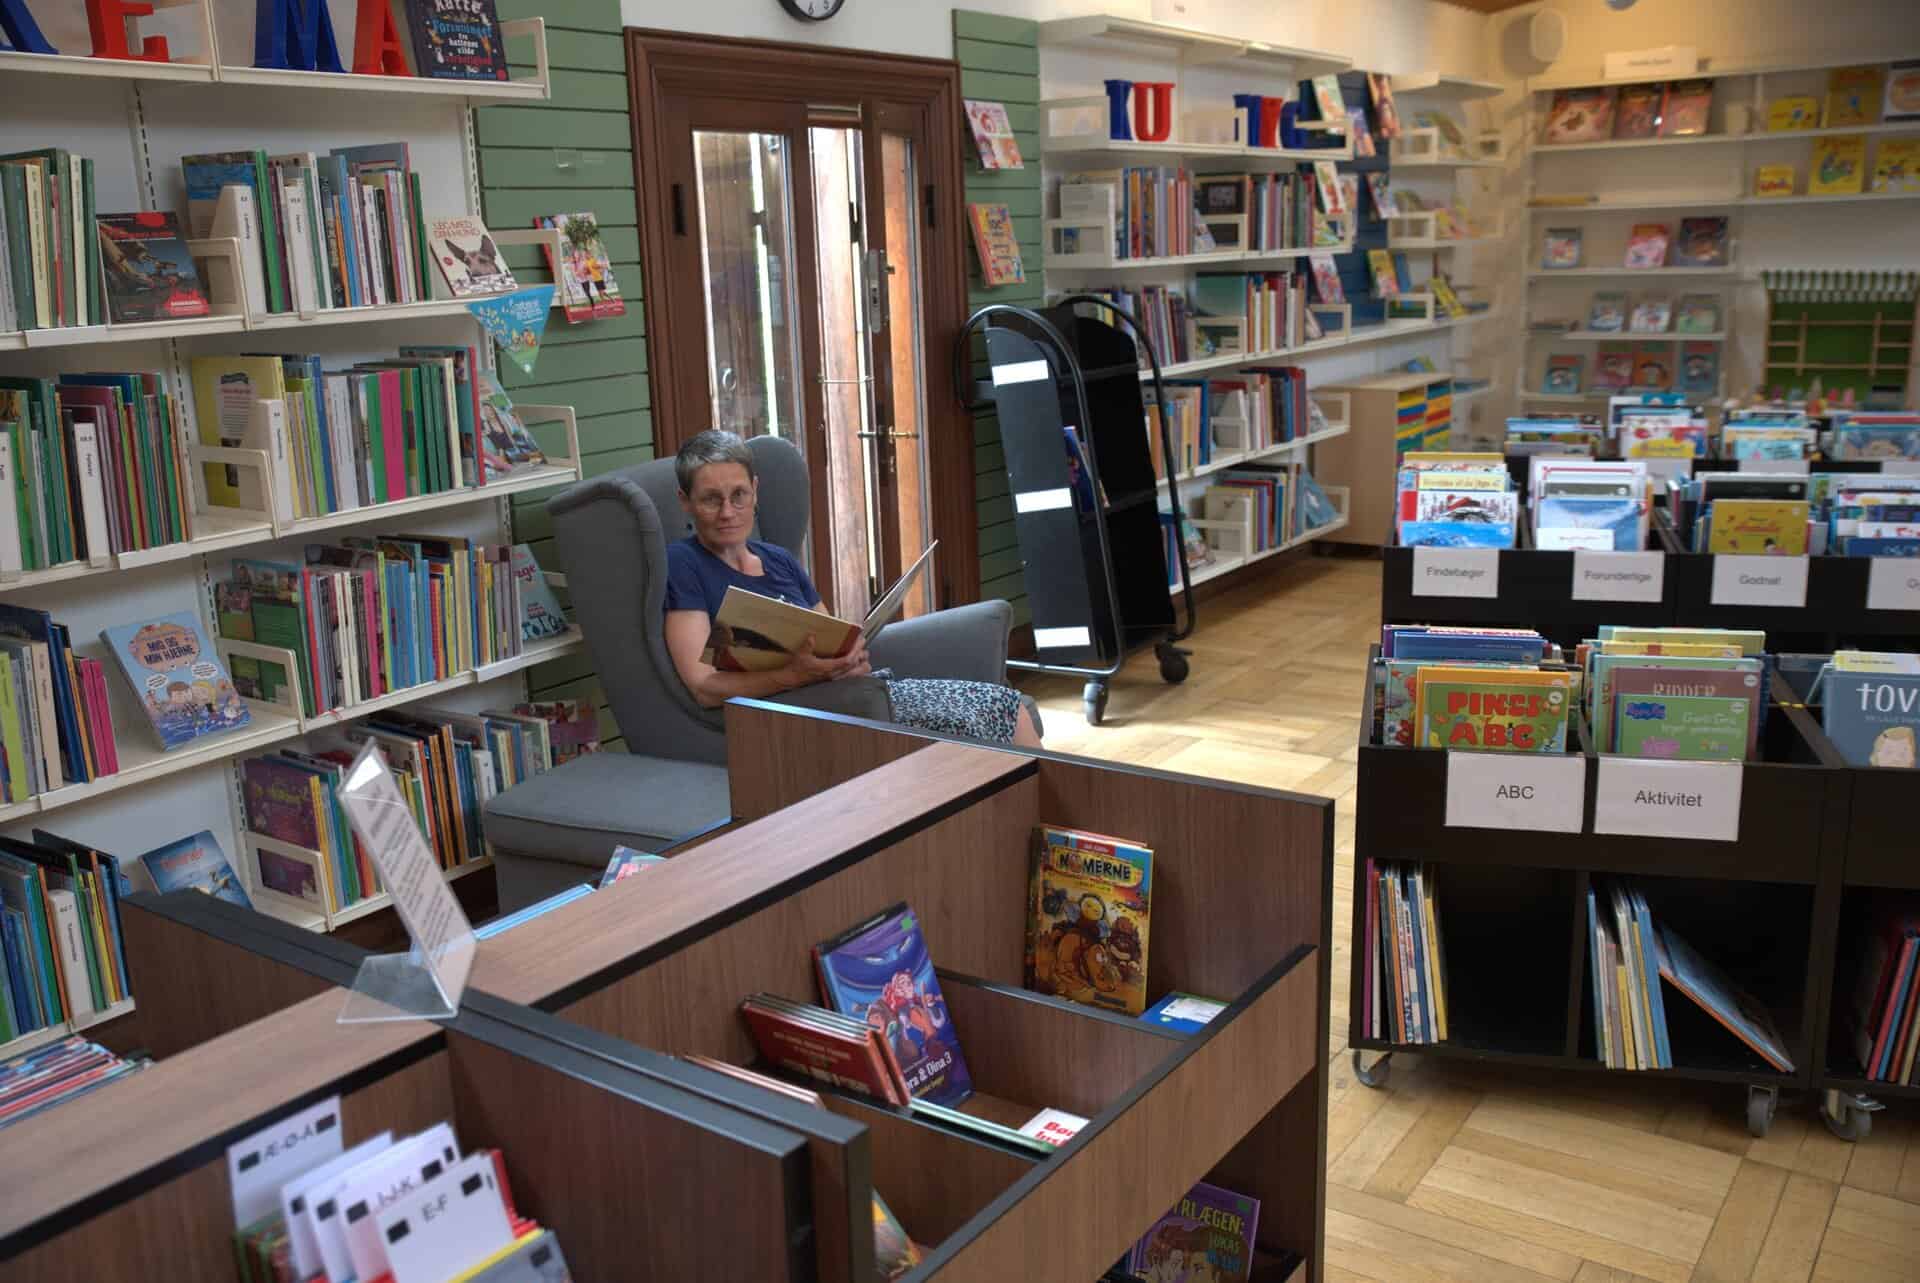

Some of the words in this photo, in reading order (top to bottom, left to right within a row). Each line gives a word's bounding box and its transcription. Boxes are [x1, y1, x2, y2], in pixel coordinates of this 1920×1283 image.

[1449, 722, 1536, 749] ABC
[1495, 784, 1534, 800] ABC
[1634, 790, 1703, 808] Aktivitet
